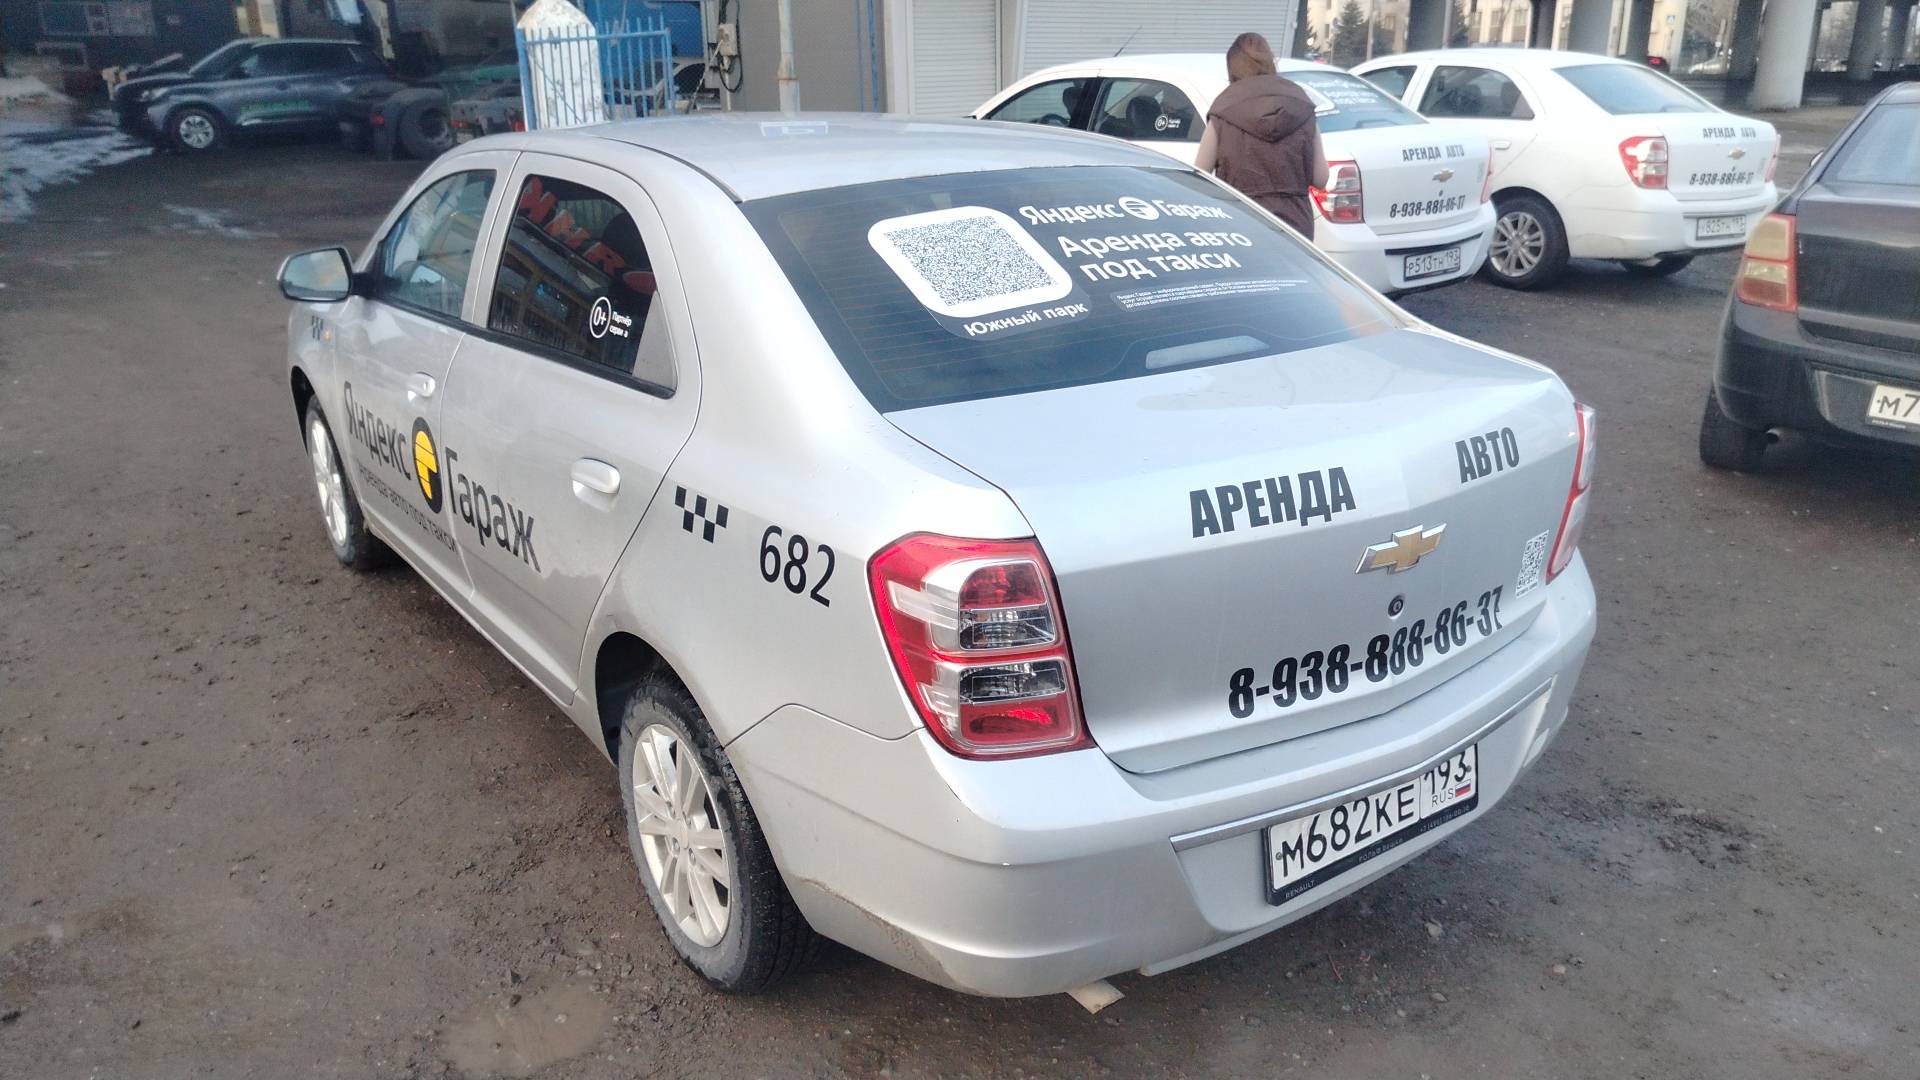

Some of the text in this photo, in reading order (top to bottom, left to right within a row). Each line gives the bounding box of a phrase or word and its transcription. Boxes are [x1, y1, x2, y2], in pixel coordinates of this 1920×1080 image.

[1703, 127, 1735, 138] АРЕНДА
[1402, 144, 1465, 161] АРЕНДА АВТО
[1019, 199, 1233, 226] Яндекс Гараж
[1057, 231, 1253, 258] Аренда авто
[1079, 252, 1241, 281] под такси
[963, 303, 1089, 337] Южный парк
[1879, 393, 1920, 418] М7
[344, 380, 541, 573] Яндекс Гараж
[1189, 427, 1520, 539] АРЕНДА АВТО
[759, 525, 836, 608] 682
[1228, 585, 1503, 719] 8-938-888-86-37
[1431, 787, 1454, 808] RUS
[1281, 783, 1415, 878] М682КЕ
[1423, 750, 1467, 795] 193
